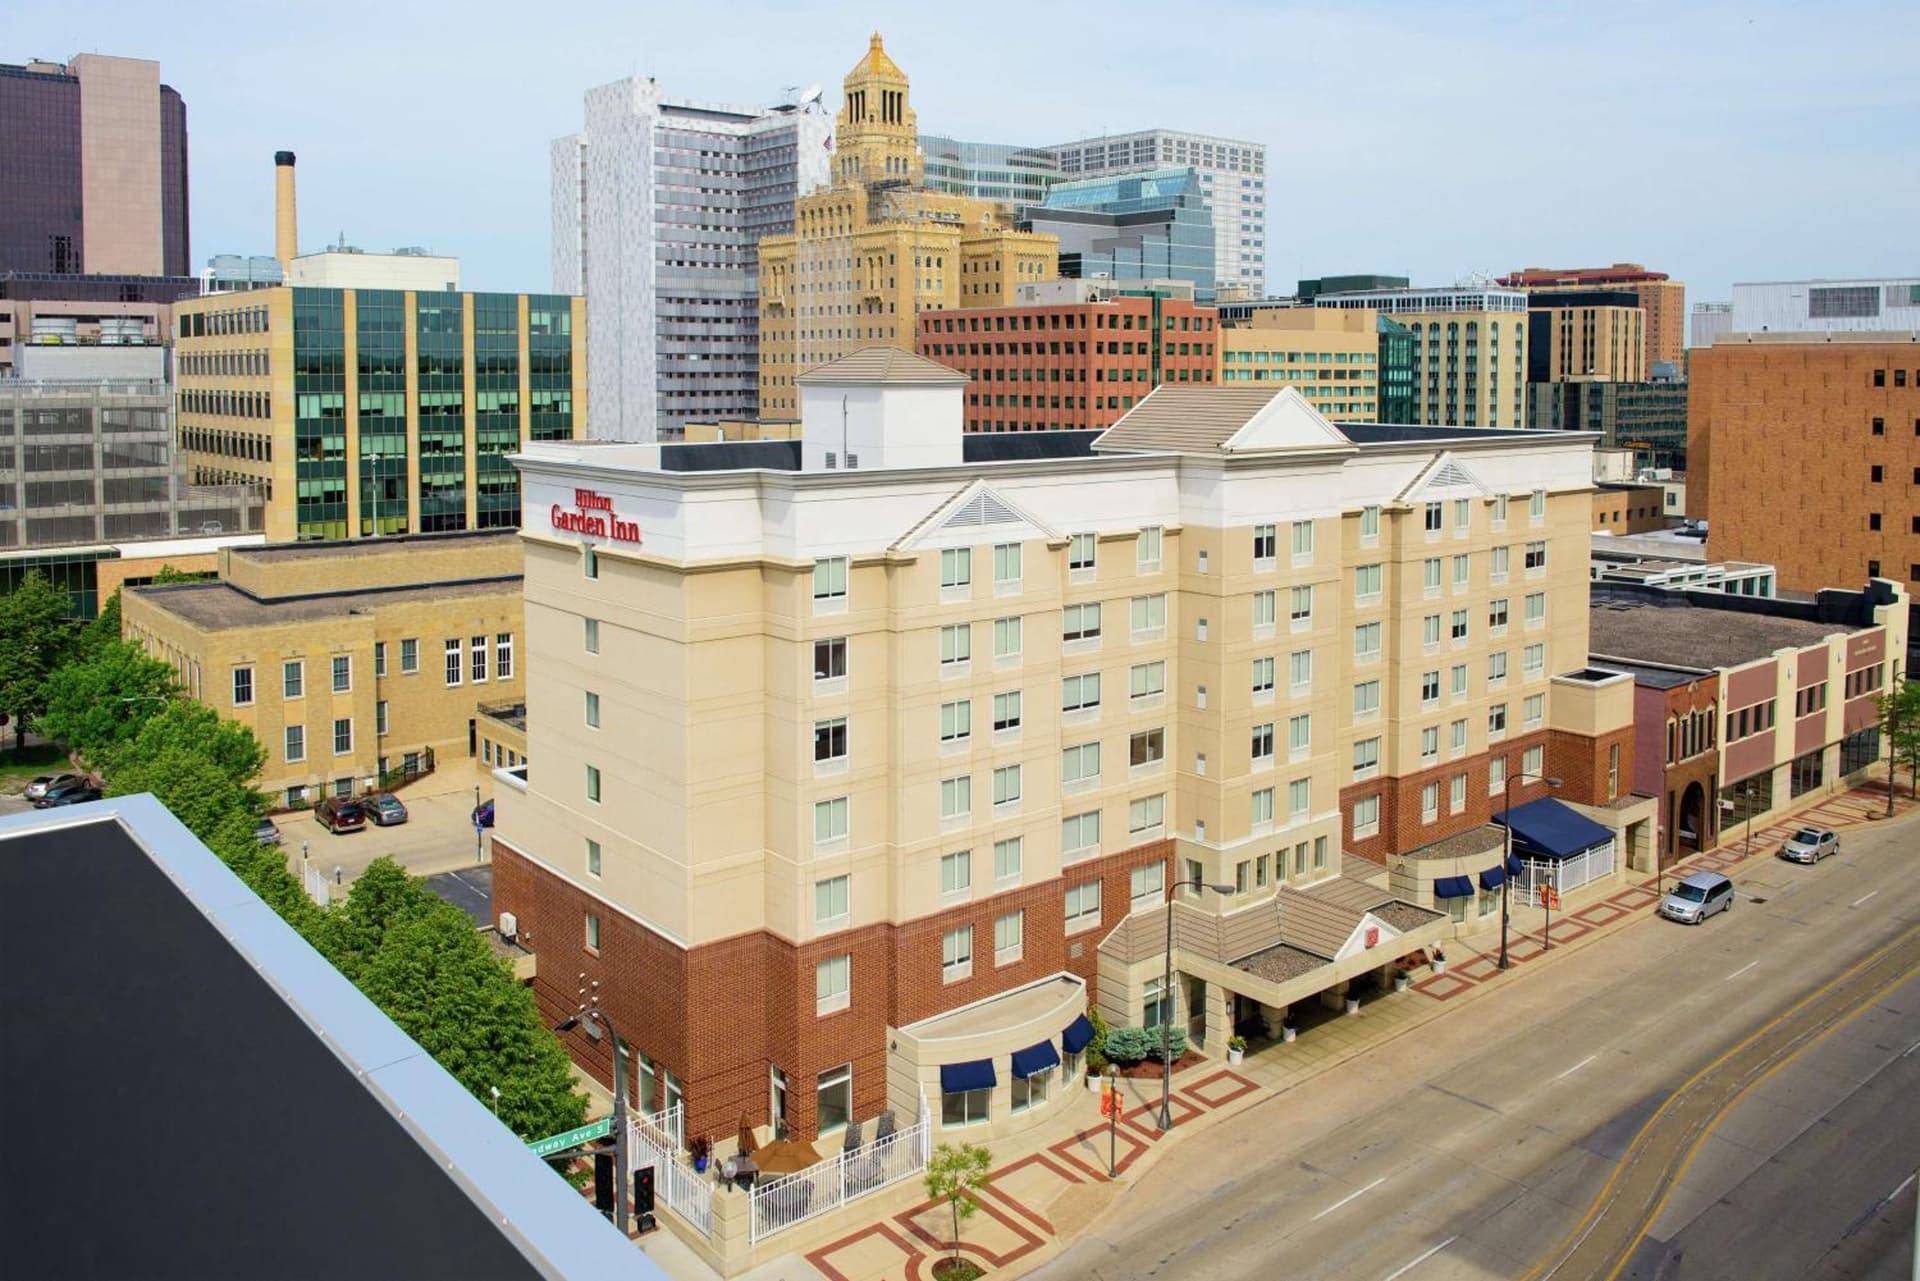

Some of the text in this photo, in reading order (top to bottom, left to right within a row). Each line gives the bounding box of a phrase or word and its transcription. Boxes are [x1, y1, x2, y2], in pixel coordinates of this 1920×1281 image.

[575, 488, 612, 511] Hilton
[551, 504, 641, 543] Garden Inn
[572, 1130, 591, 1142] Ave
[596, 1124, 603, 1134] S
